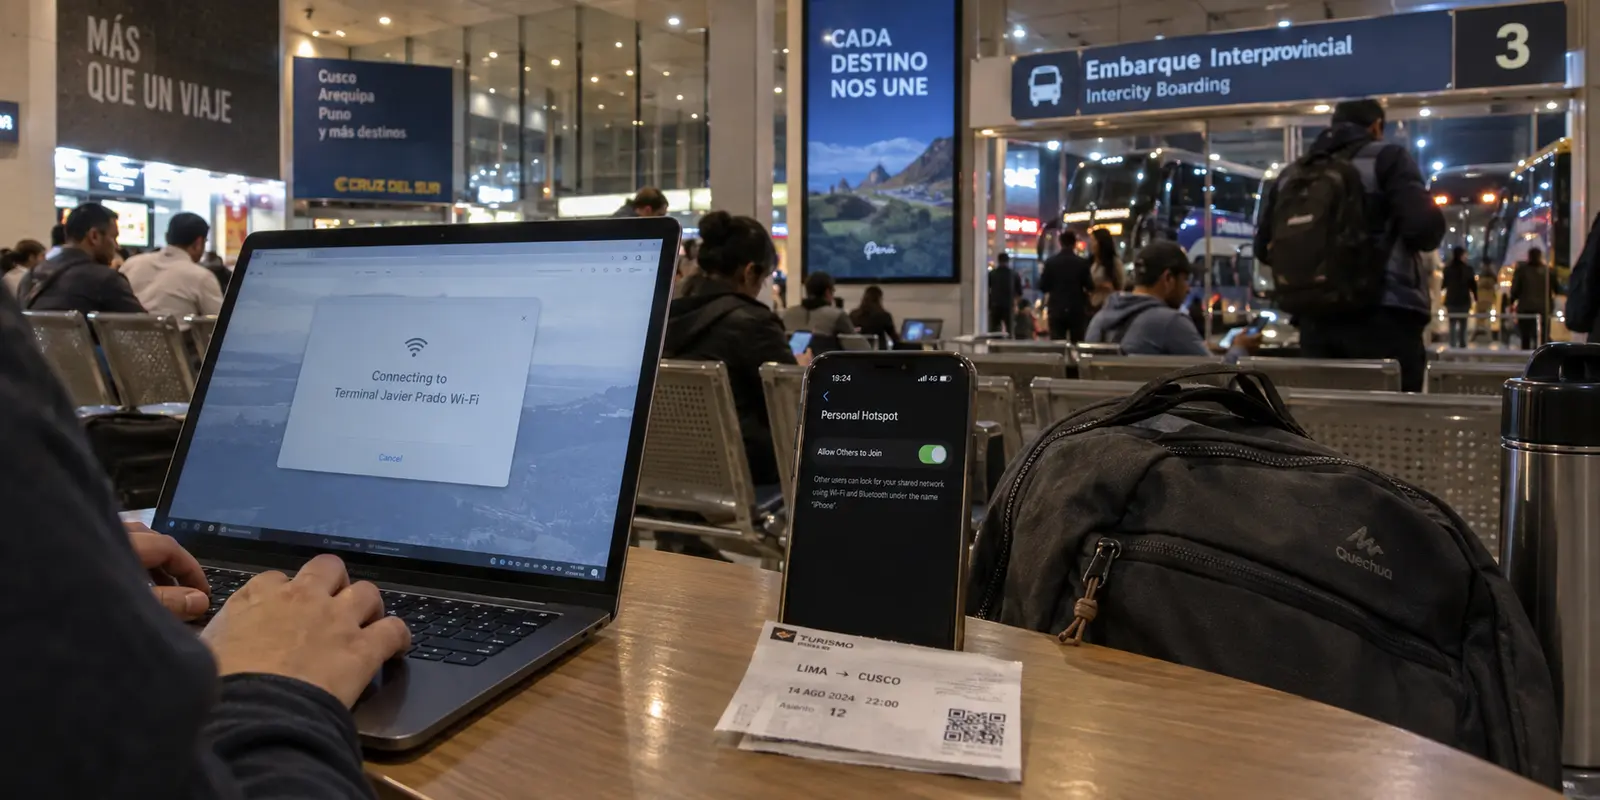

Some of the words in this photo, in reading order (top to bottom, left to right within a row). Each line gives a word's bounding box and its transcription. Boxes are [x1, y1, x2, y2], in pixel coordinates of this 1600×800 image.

[87, 13, 140, 63] MÁS
[831, 28, 892, 48] CADA
[1495, 22, 1530, 70] 3
[831, 51, 928, 73] DESTINO
[1086, 52, 1201, 81] Embarque
[1210, 34, 1353, 67] Interprovincial
[318, 69, 357, 84] Cusco
[87, 61, 136, 105] QUE
[143, 72, 173, 112] UN
[179, 80, 232, 124] VIAJE
[318, 87, 375, 104] Arequipa
[831, 78, 877, 98] NOS
[883, 77, 928, 97] UNE
[1086, 84, 1151, 104] Intercity
[1156, 77, 1231, 98] Boarding
[318, 106, 352, 120] Puno
[318, 127, 327, 141] y
[329, 125, 355, 138] más
[357, 125, 407, 139] destinos
[387, 179, 412, 193] DEL
[414, 180, 441, 195] SUR
[371, 370, 433, 386] Connecting
[436, 373, 447, 384] to
[334, 387, 379, 400] Terminal
[380, 390, 413, 402] Javier
[415, 391, 447, 404] Prado
[450, 393, 480, 405] Wi-Fi
[821, 410, 860, 420] Personal
[862, 410, 898, 422] Hotspot
[378, 453, 404, 463] Cancel
[817, 448, 835, 456] Allow
[836, 448, 858, 457] Others
[860, 449, 866, 457] to
[868, 449, 882, 457] Join
[813, 475, 831, 483] Other
[848, 477, 859, 485] can
[860, 477, 873, 485] look
[873, 477, 882, 485] for
[883, 479, 897, 487] your
[897, 479, 919, 487] shared
[919, 480, 945, 488] network
[858, 490, 889, 498] Bluetooth
[889, 491, 907, 499] under
[909, 492, 919, 500] the
[920, 493, 938, 501] name
[1336, 546, 1393, 580] Quechua
[800, 634, 854, 649] TURISMO
[796, 663, 828, 676] LIMA
[858, 672, 901, 686] CUSCO
[788, 686, 801, 694] 14
[802, 688, 825, 698] AGO
[828, 691, 855, 702] 2024
[865, 697, 899, 708] 22:00
[779, 702, 815, 713] Asiento
[829, 707, 847, 718] 12
